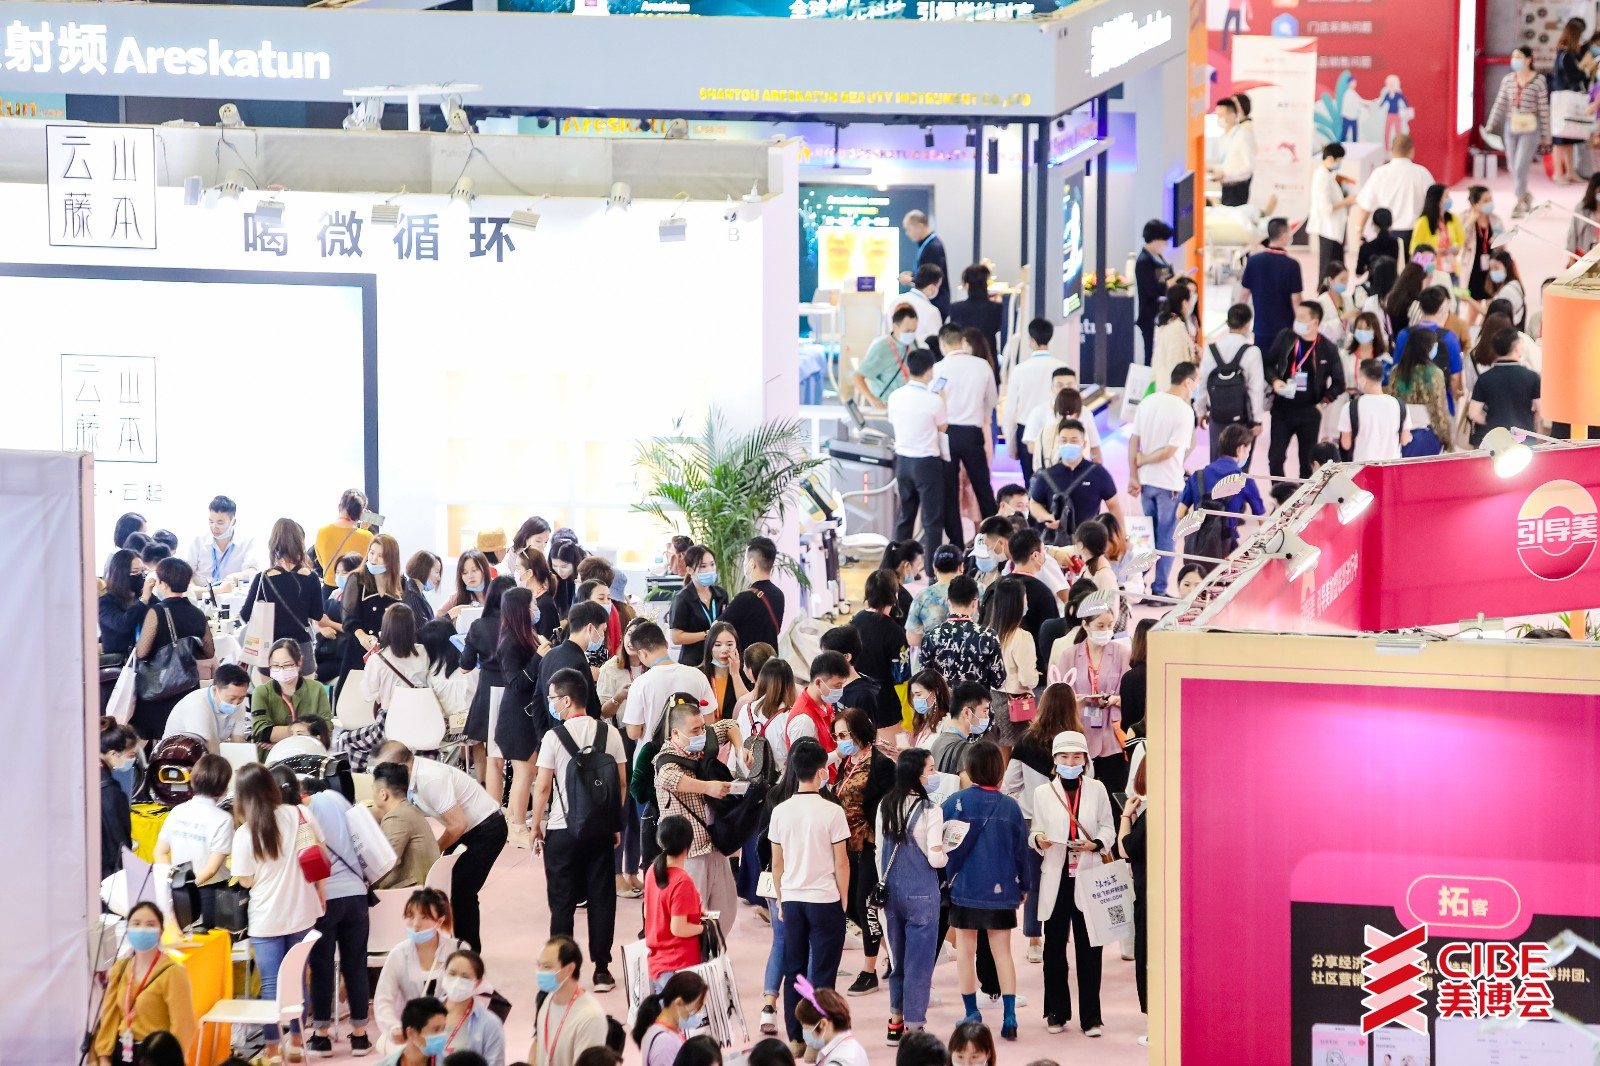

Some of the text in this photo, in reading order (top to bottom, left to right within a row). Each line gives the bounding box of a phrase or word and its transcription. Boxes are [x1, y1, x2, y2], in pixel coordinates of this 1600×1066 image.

[113, 36, 331, 80] Areskatun
[243, 211, 517, 263] 喝微循环
[1516, 514, 1599, 546] 引导美
[1438, 885, 1489, 917] 拓客
